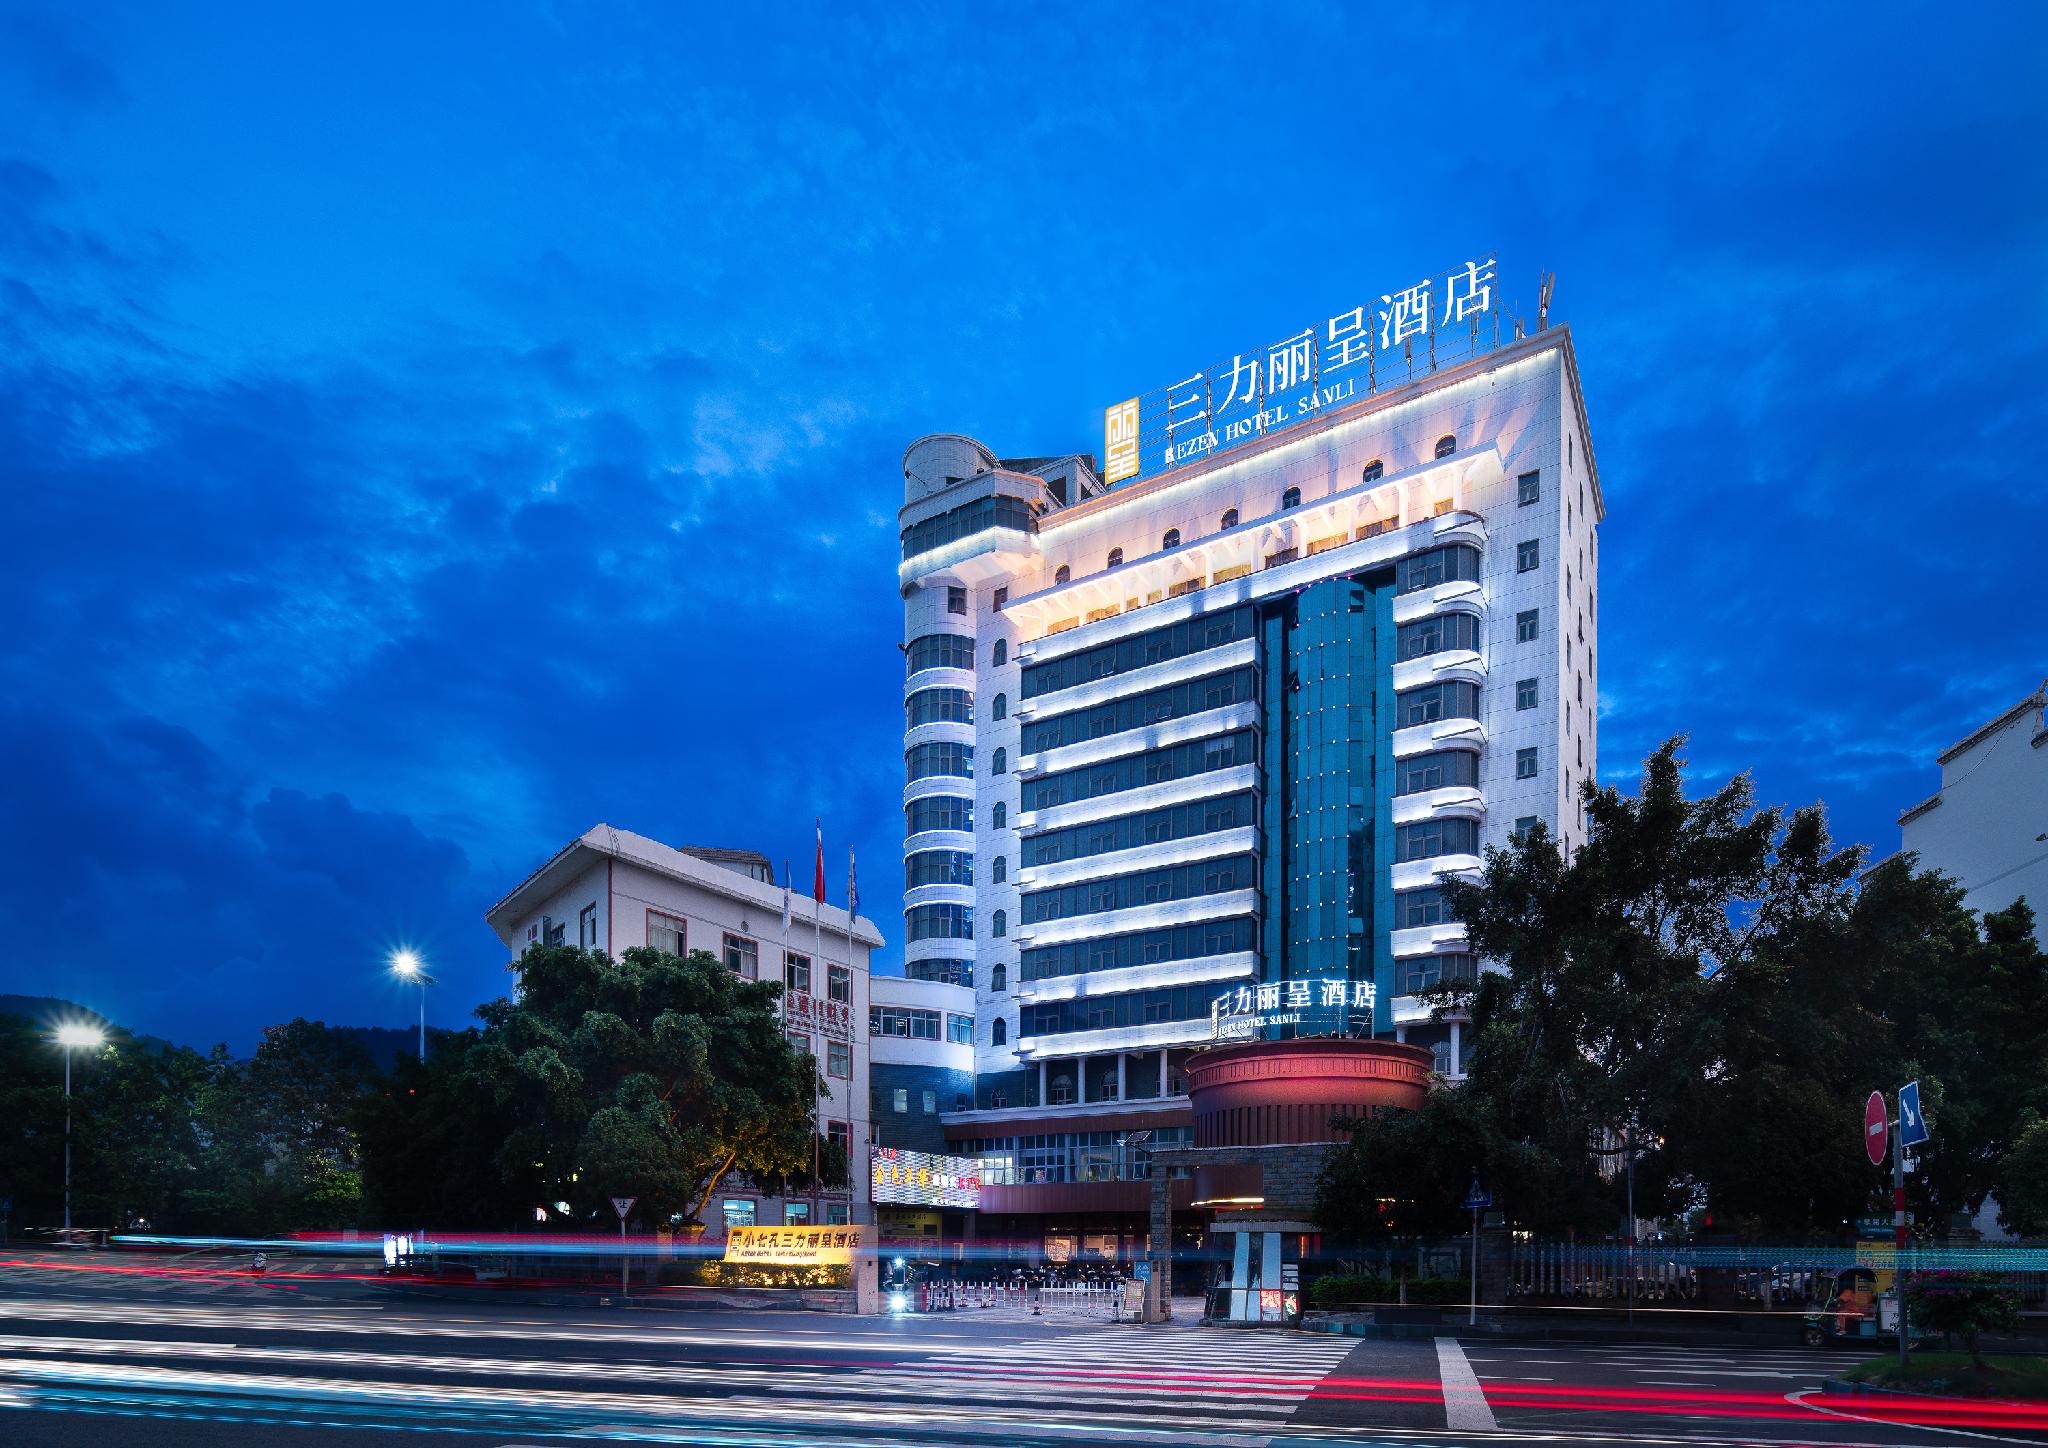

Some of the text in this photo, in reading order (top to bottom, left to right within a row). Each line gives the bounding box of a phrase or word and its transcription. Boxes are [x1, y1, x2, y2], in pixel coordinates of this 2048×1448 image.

[1165, 258, 1497, 431] 三力丽呈酒店
[1165, 378, 1355, 464] REZEN HOTEL SANLI
[1238, 1016, 1266, 1029] HOTEL
[1269, 1013, 1300, 1025] SANLI
[743, 1231, 861, 1249] 小七孔三力丽呈酒店
